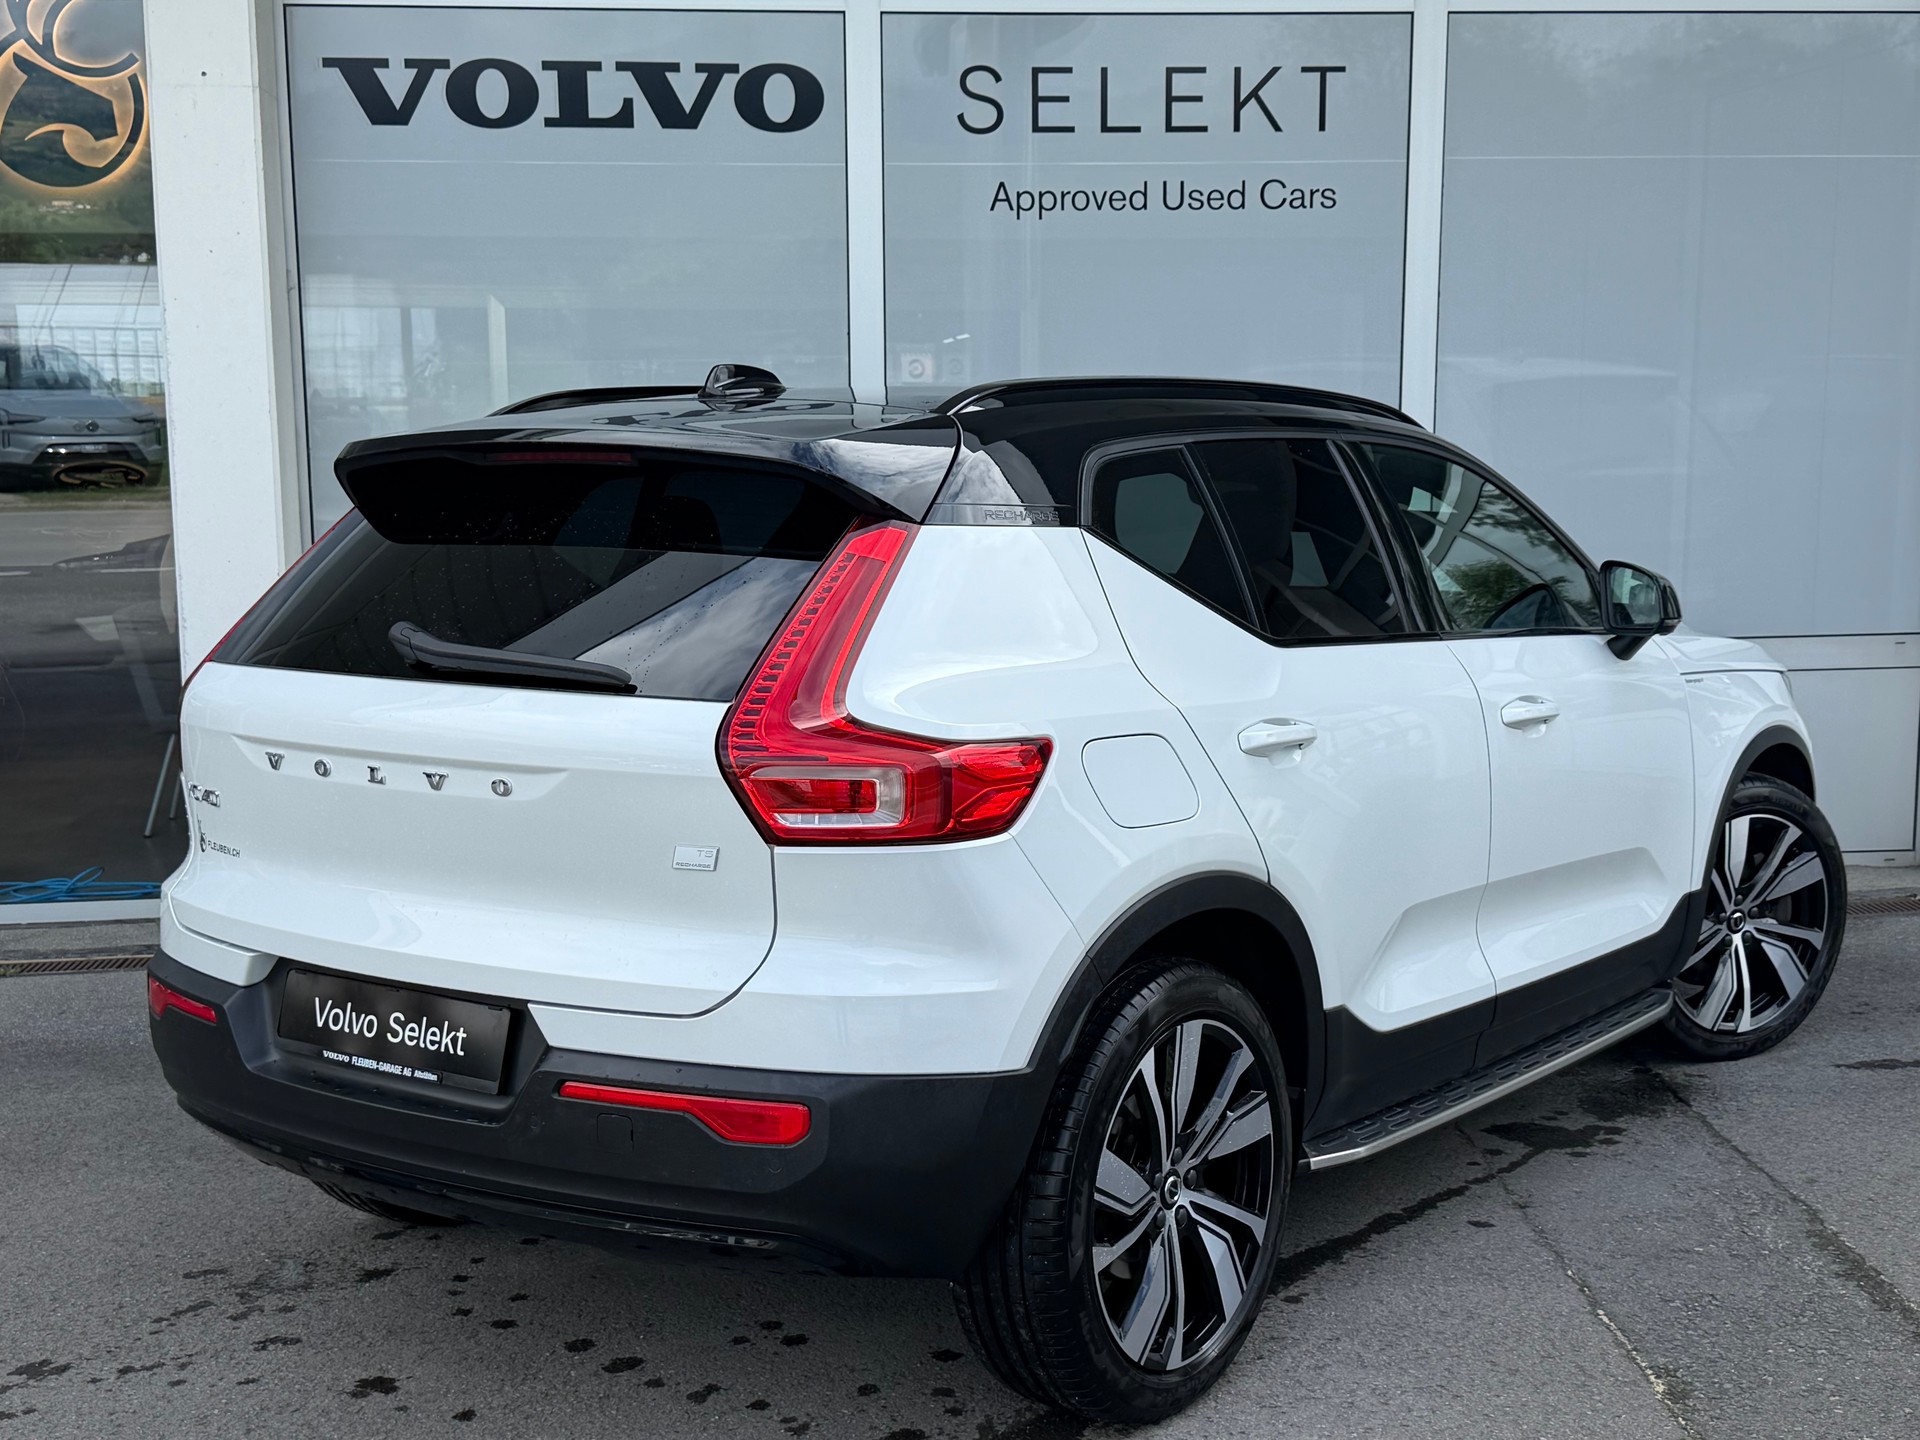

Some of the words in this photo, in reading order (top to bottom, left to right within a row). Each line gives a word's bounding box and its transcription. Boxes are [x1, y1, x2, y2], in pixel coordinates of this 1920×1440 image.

[322, 57, 825, 133] VOLVO
[956, 64, 1347, 135] SELEKT
[990, 181, 1148, 220] Approved
[1162, 180, 1246, 211] Used
[1259, 179, 1337, 210] Cars
[984, 509, 1060, 522] RECHARGE
[265, 751, 513, 798] VOLVO
[314, 997, 378, 1038] Volvo
[386, 1011, 468, 1056] Selekt
[322, 1050, 350, 1063] VOLVO
[403, 1066, 412, 1077] AG
